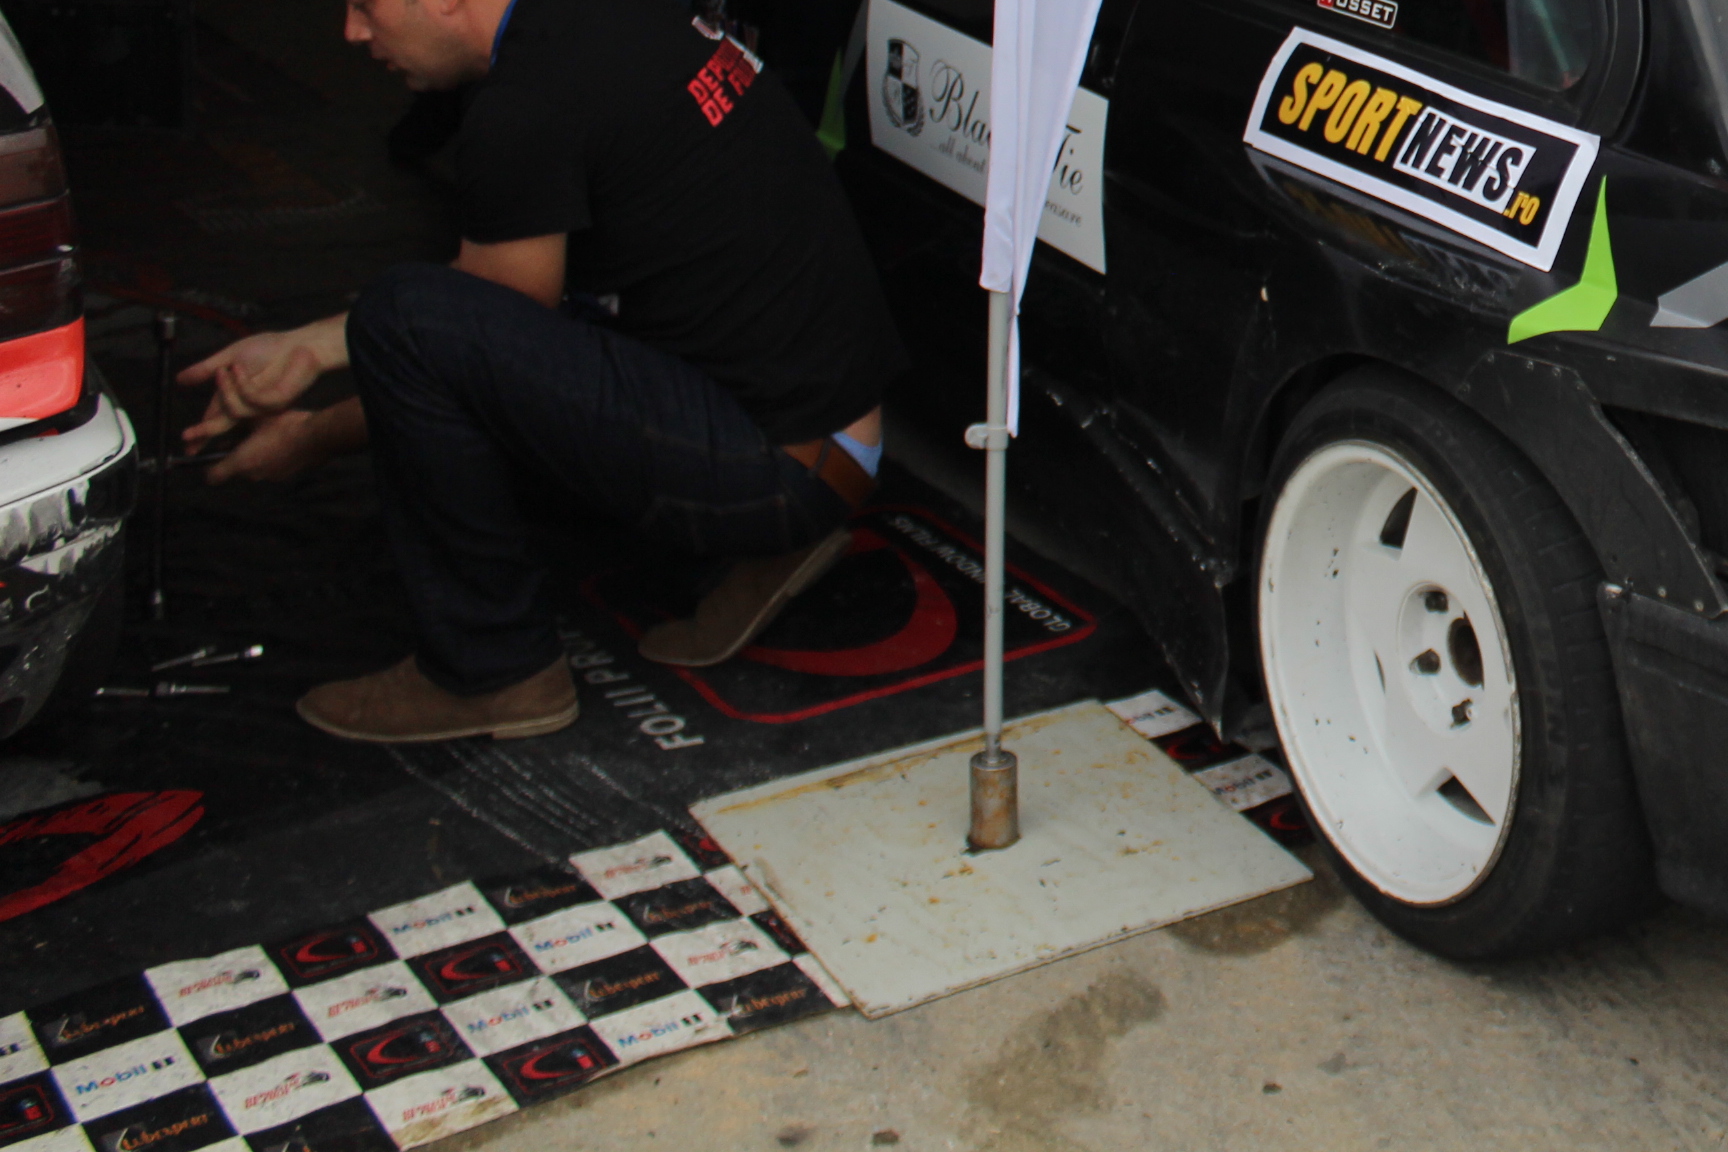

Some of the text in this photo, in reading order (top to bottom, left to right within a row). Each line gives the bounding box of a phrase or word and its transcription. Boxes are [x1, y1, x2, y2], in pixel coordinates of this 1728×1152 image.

[534, 927, 593, 952] Mobil
[618, 1022, 679, 1048] Mobil
[75, 1063, 148, 1095] Mobil
